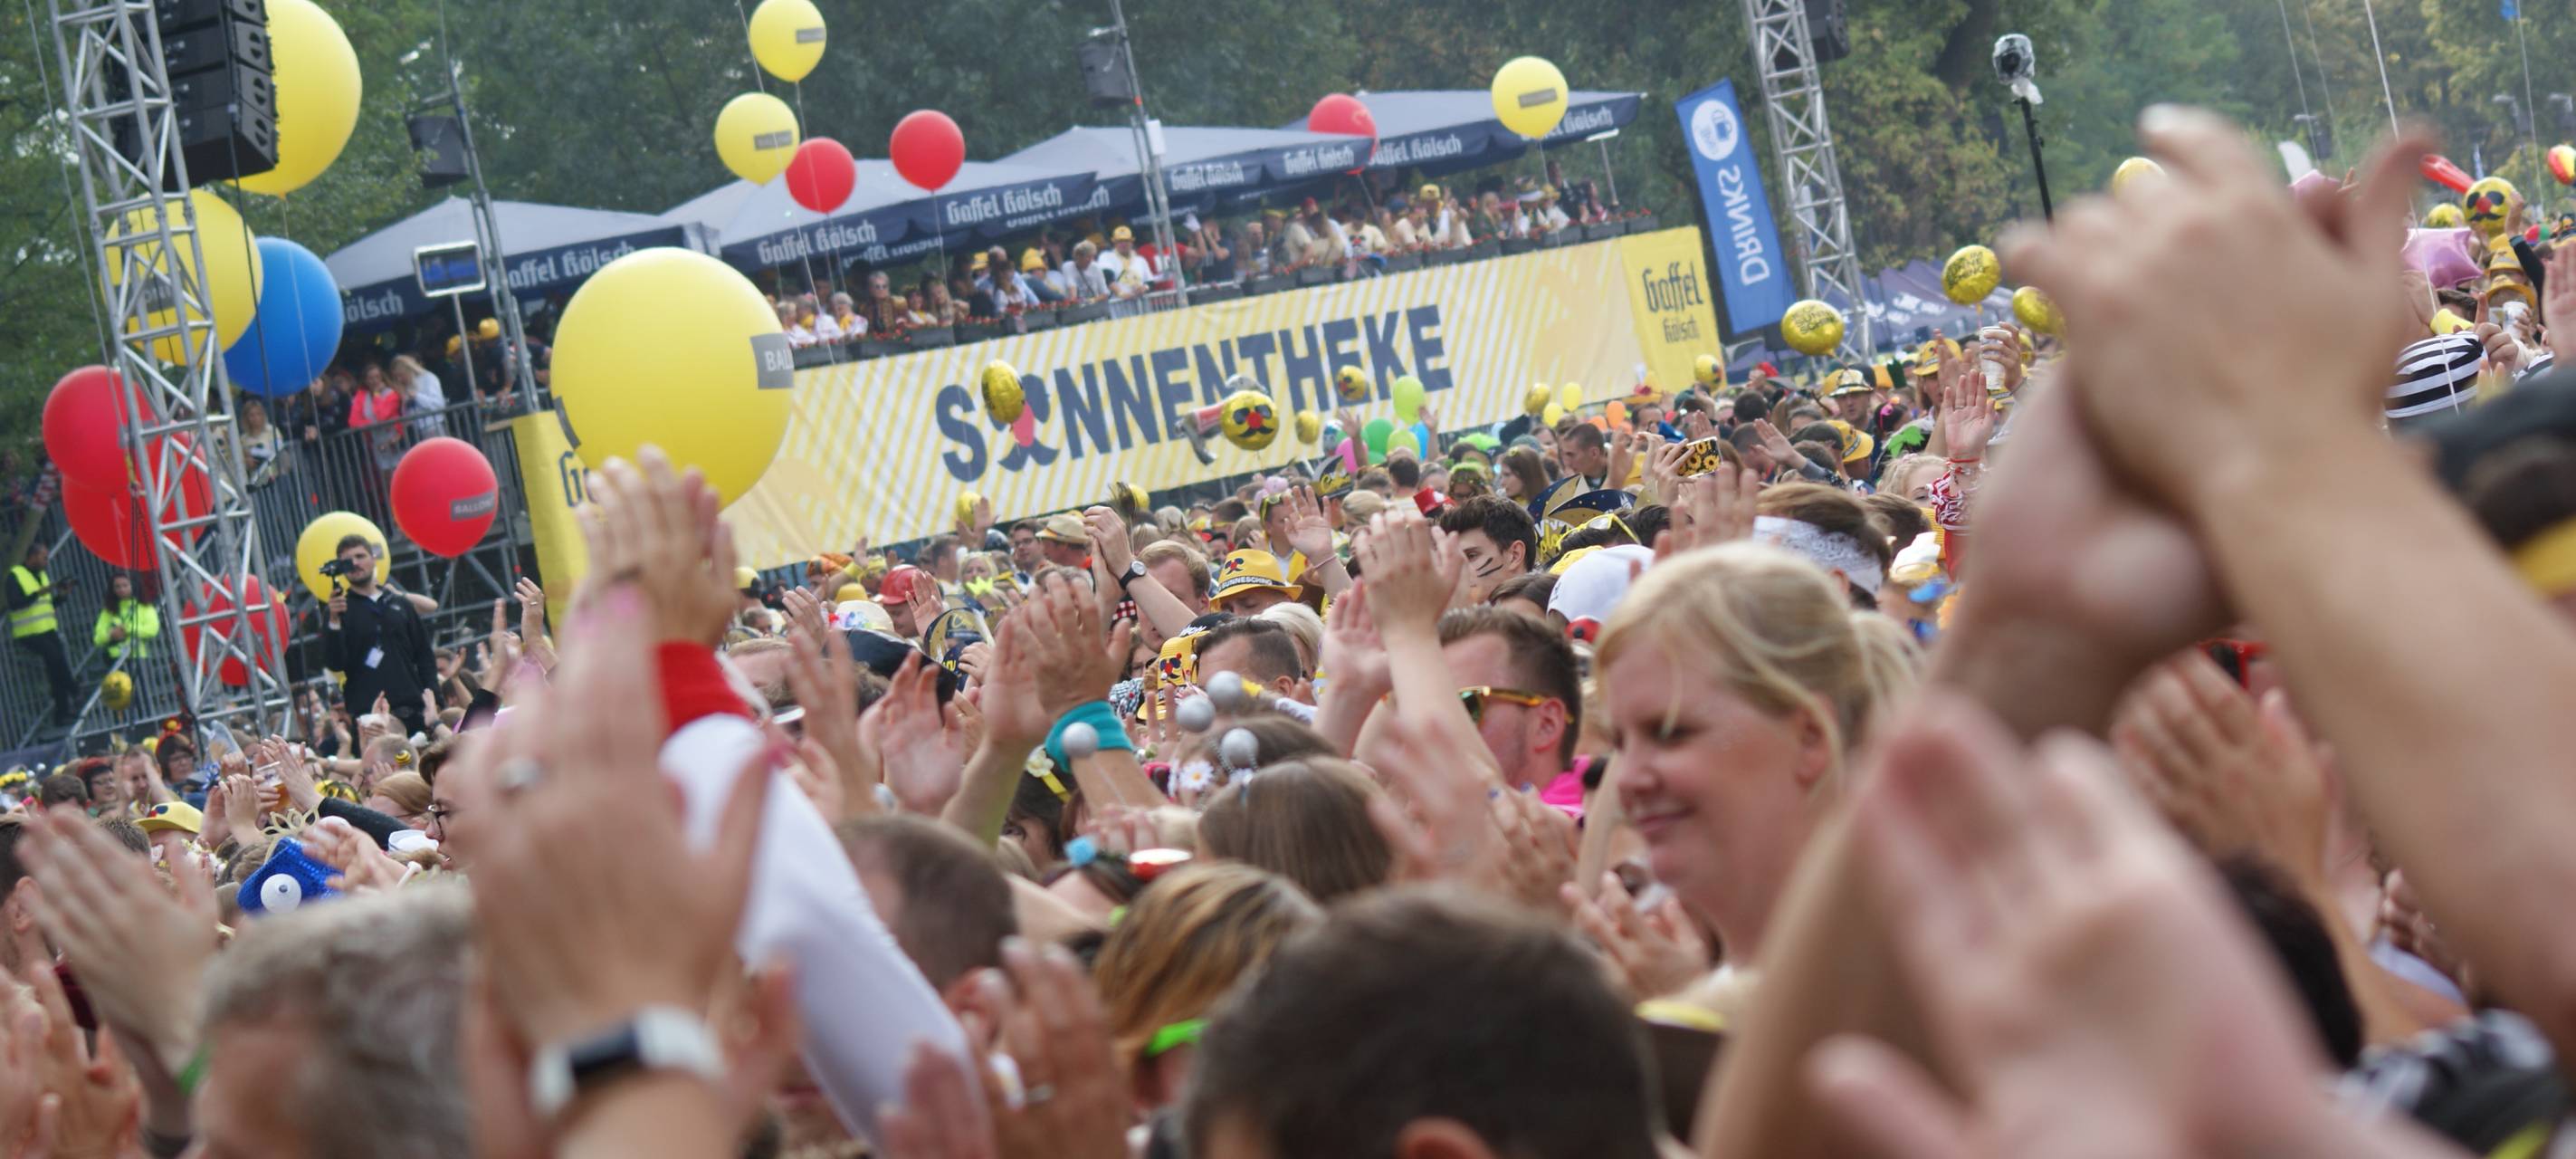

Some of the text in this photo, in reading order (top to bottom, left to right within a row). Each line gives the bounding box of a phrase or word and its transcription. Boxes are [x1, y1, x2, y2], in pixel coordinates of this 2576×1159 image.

[1410, 133, 1463, 159] Kölsch
[946, 193, 1002, 225] Gaffel
[1003, 183, 1063, 215] Kölsch
[757, 232, 814, 264] Gaffel
[816, 219, 877, 252] Kölsch
[507, 255, 559, 289] affel
[1642, 260, 1704, 312] Gaffel
[346, 289, 404, 322] ölsch
[1662, 313, 1701, 344] Kölsch
[935, 304, 1454, 482] SNNENTHEKE
